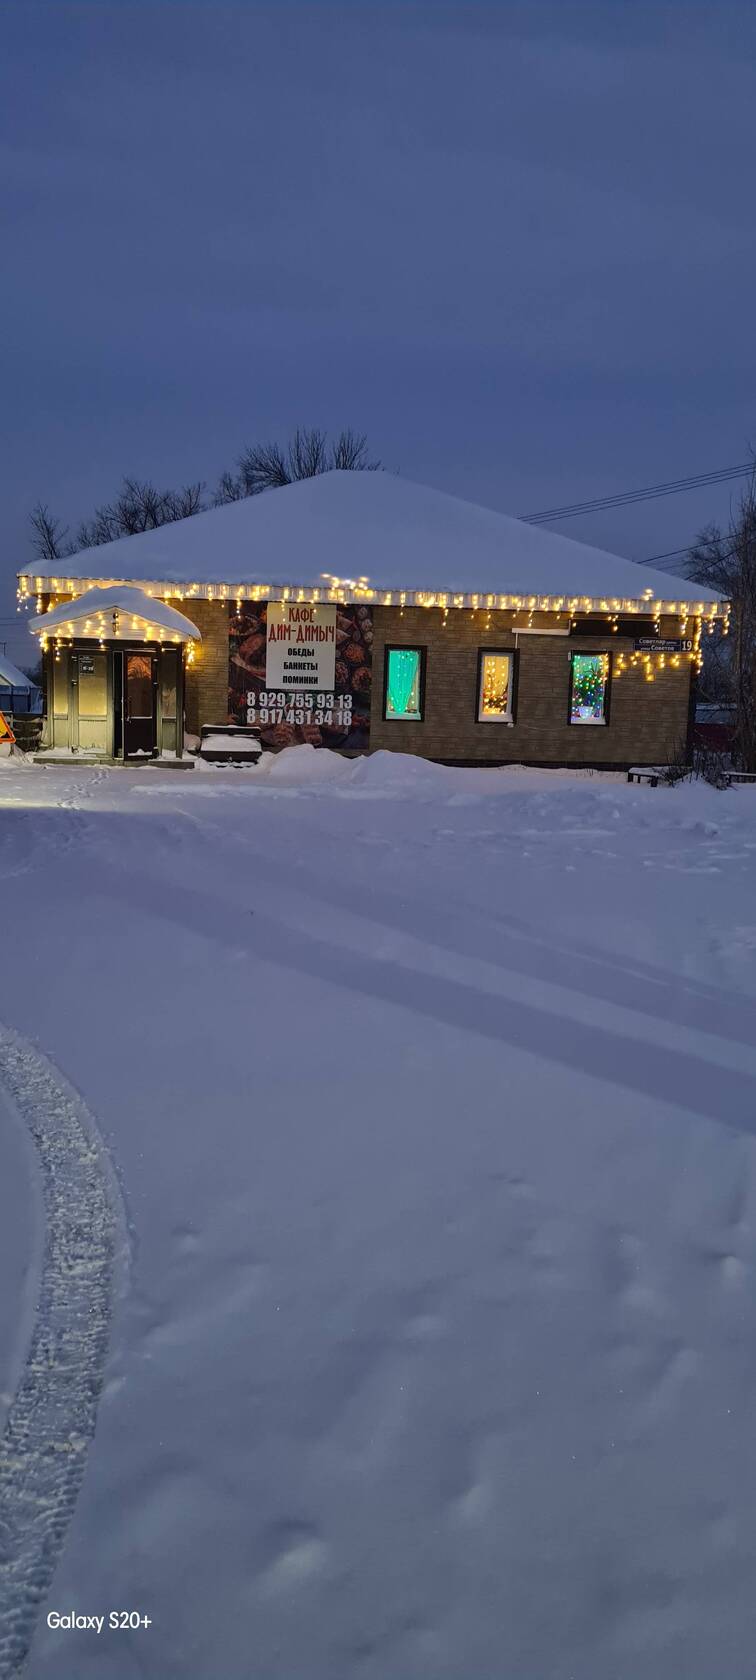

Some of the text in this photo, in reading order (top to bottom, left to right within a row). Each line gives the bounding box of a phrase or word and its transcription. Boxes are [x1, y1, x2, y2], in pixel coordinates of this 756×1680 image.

[288, 607, 315, 623] КАФЕ
[268, 624, 335, 643] ДИМ-ДИМЫЧ
[682, 641, 692, 651] 19
[287, 648, 315, 658] ОБЕДЫ
[283, 662, 318, 671] БАНКЕТЫ
[282, 675, 319, 685] ПОМИНКИ
[246, 692, 353, 709] 8 929 755 93 13
[246, 708, 353, 726] 8 917 431 34 18
